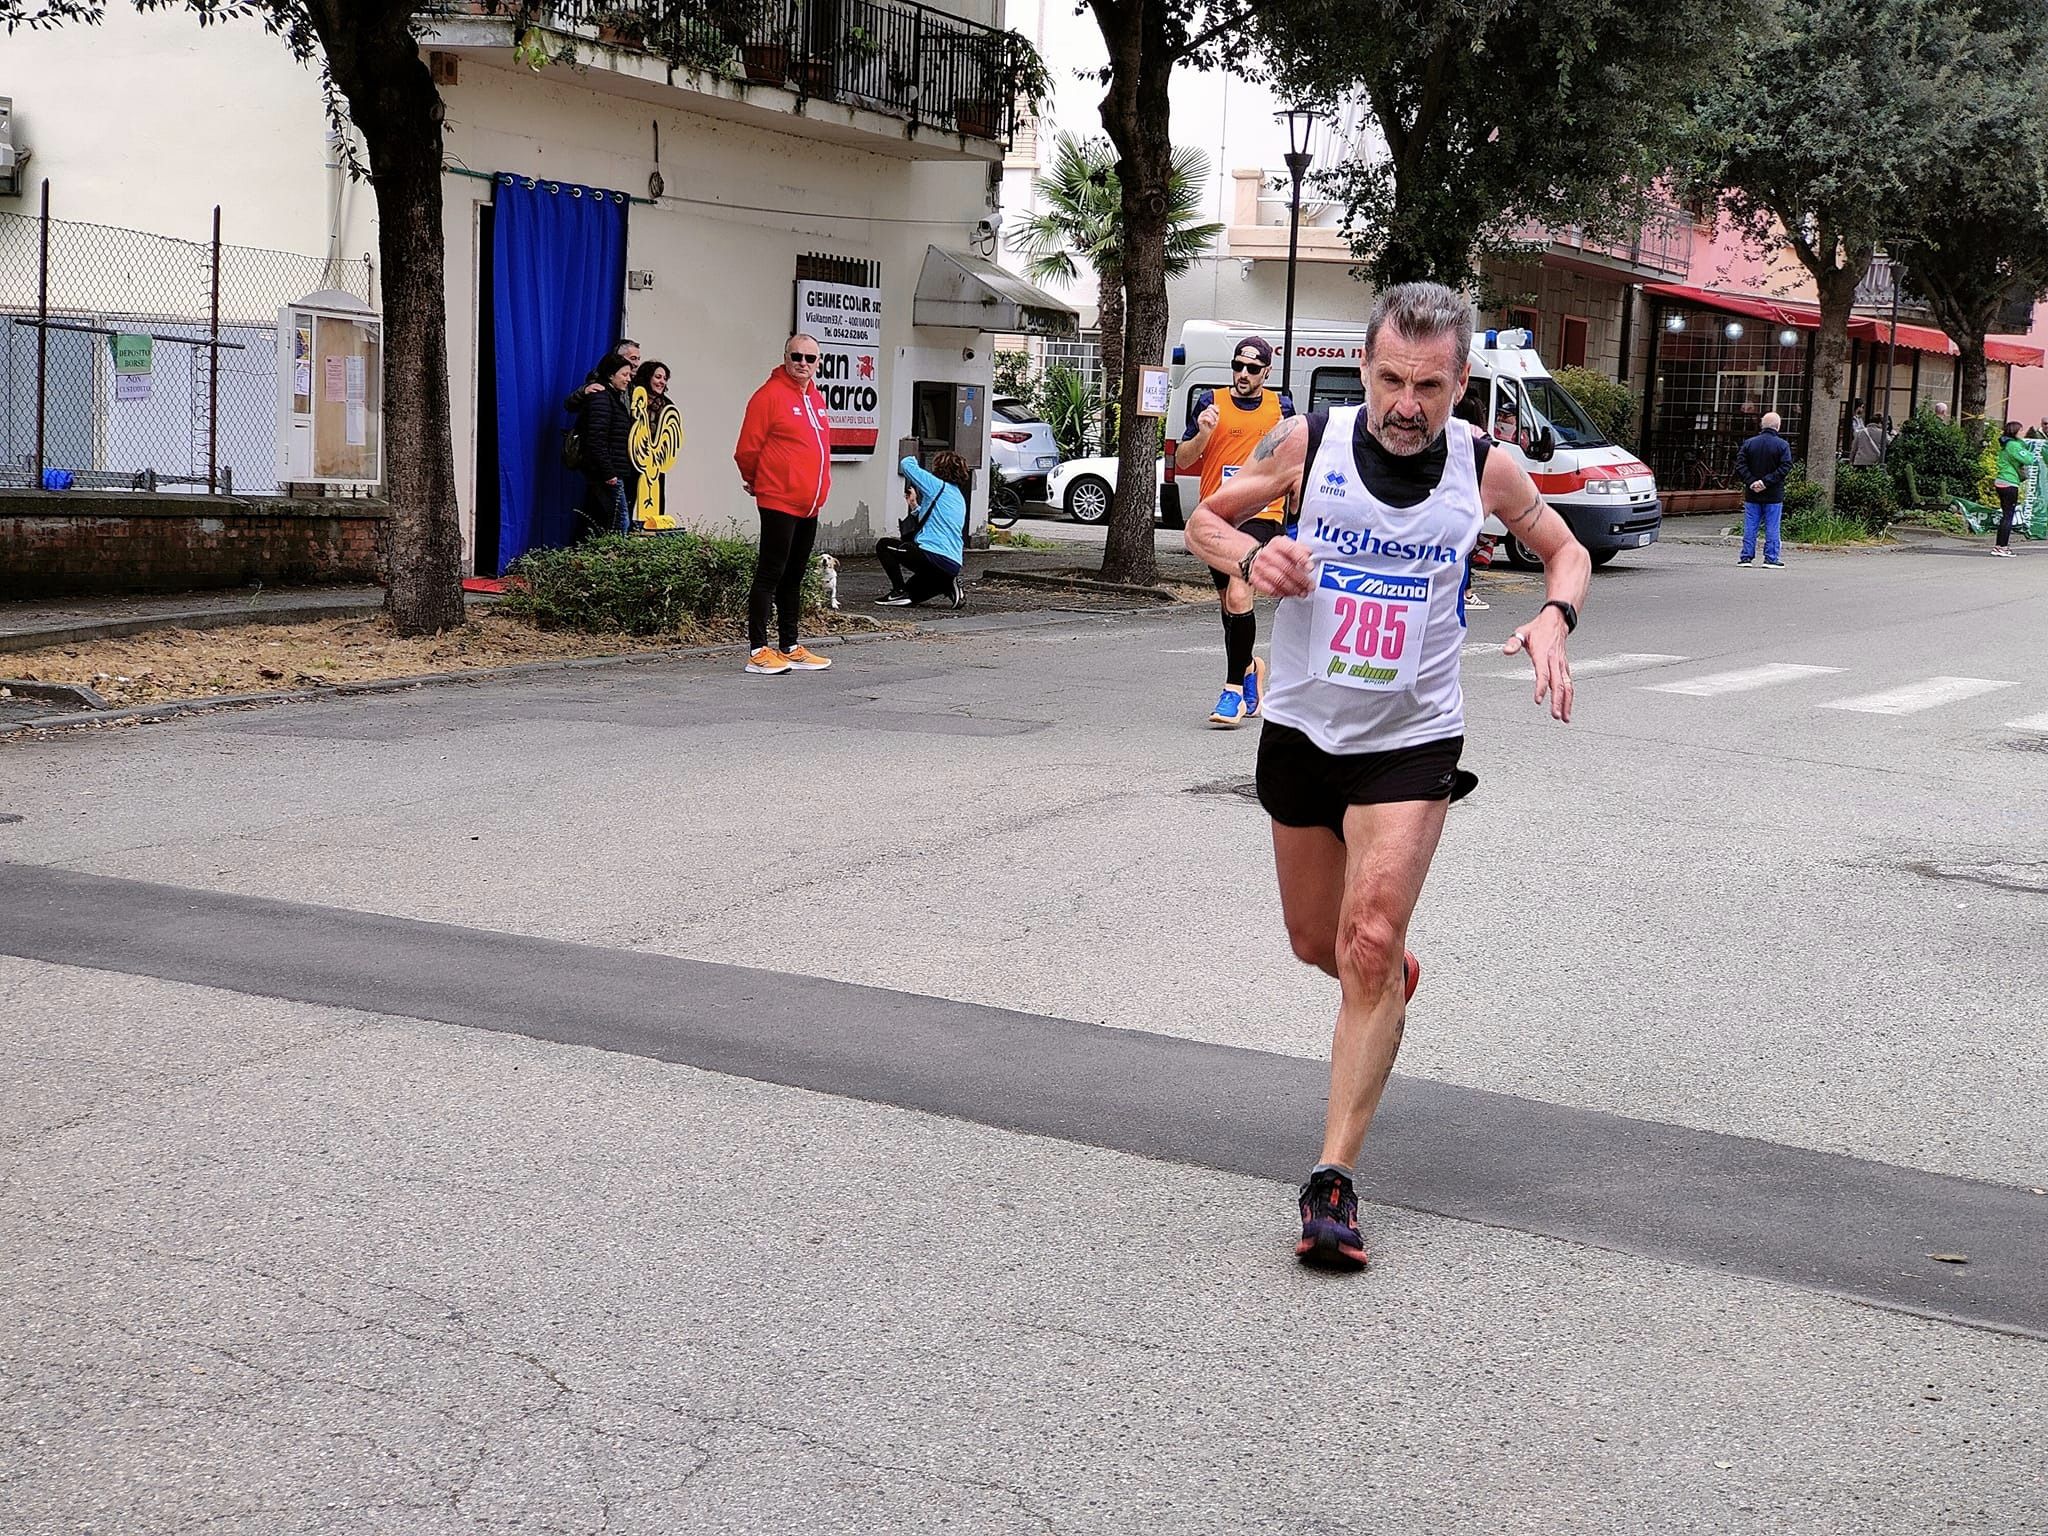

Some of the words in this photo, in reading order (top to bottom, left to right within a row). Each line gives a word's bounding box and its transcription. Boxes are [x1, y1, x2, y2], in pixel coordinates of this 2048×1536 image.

[1296, 346, 1345, 358] ROSSA
[1314, 517, 1457, 564] lughesina
[1329, 596, 1409, 660] 285
